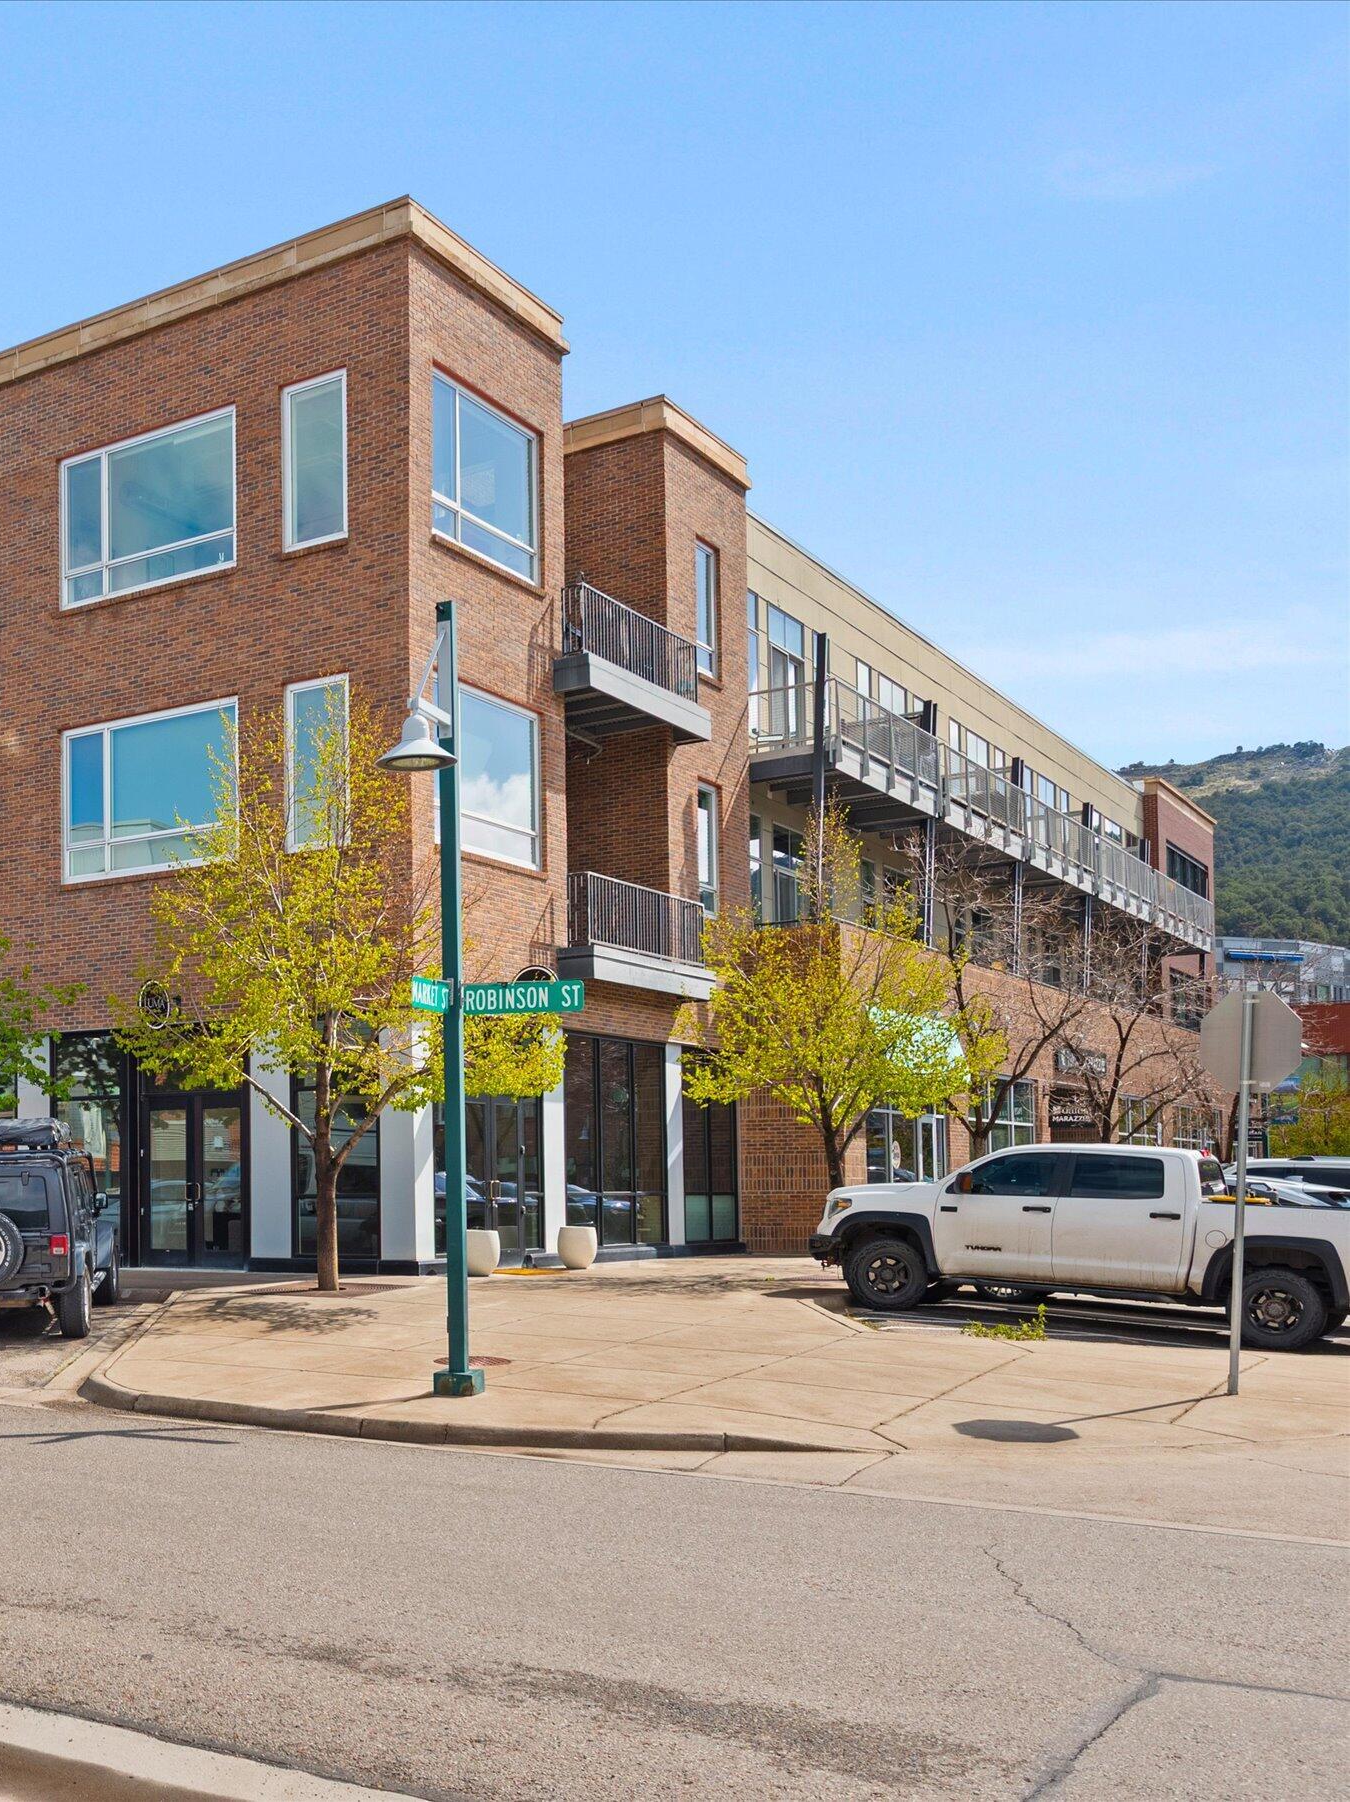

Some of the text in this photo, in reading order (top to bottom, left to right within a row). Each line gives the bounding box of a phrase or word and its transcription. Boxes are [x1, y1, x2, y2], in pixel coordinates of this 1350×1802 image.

[411, 980, 439, 1007] MARKET
[465, 985, 581, 1011] ROBINSON ST
